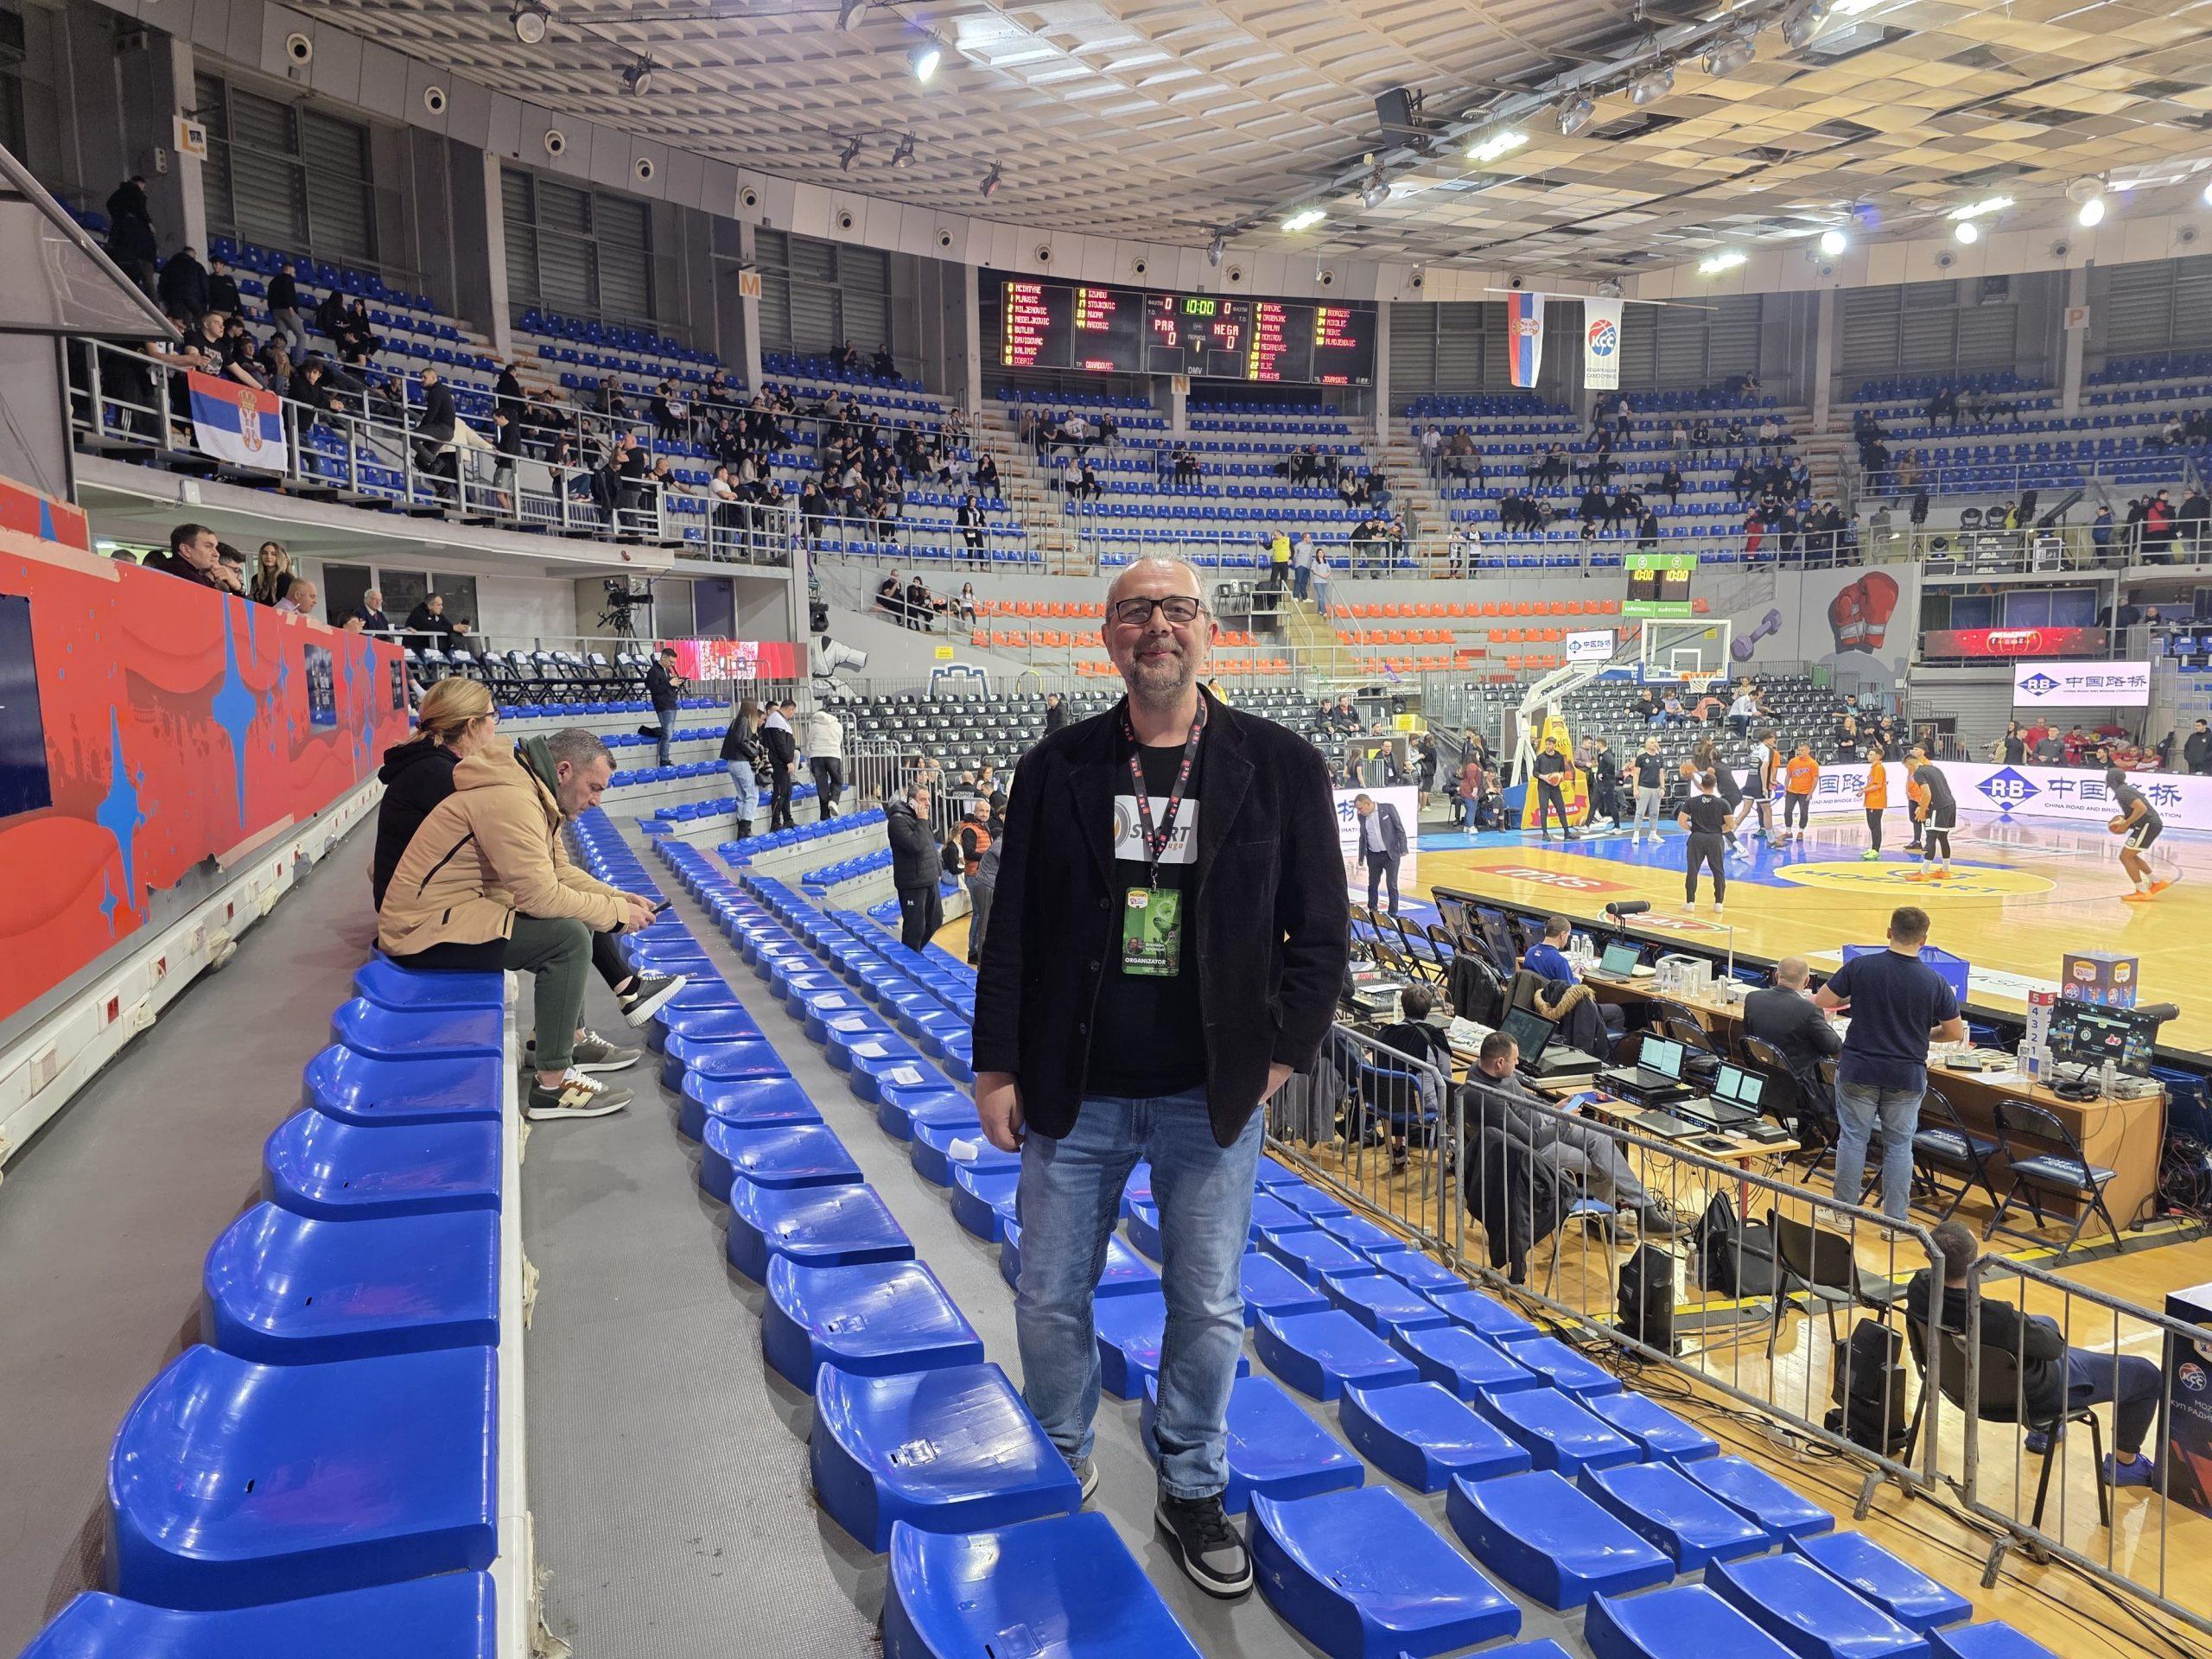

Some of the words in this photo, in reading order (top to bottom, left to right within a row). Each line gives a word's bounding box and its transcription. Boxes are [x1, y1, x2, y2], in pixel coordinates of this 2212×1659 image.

[741, 273, 760, 296] M
[1165, 297, 1173, 310] 0
[1186, 300, 1214, 315] 10:00
[1224, 302, 1231, 315] 0
[1154, 319, 1174, 332] PAR
[1214, 323, 1239, 336] MEGA
[1168, 332, 1176, 346] 0
[1227, 335, 1235, 349] 0
[1196, 340, 1201, 353] 1
[1187, 366, 1203, 375] DMV
[1174, 376, 1187, 392] N
[1634, 569, 1654, 581] 10:00
[1666, 569, 1689, 582] 10:00
[2065, 675, 2147, 688] 中国路桥
[1496, 868, 1601, 888] mts
[2032, 993, 2039, 1003] 5
[2047, 994, 2054, 1004] 5
[2032, 1007, 2038, 1015] 4
[2031, 1020, 2038, 1029] 3
[2031, 1033, 2037, 1042] 2
[2031, 1046, 2036, 1055] 1
